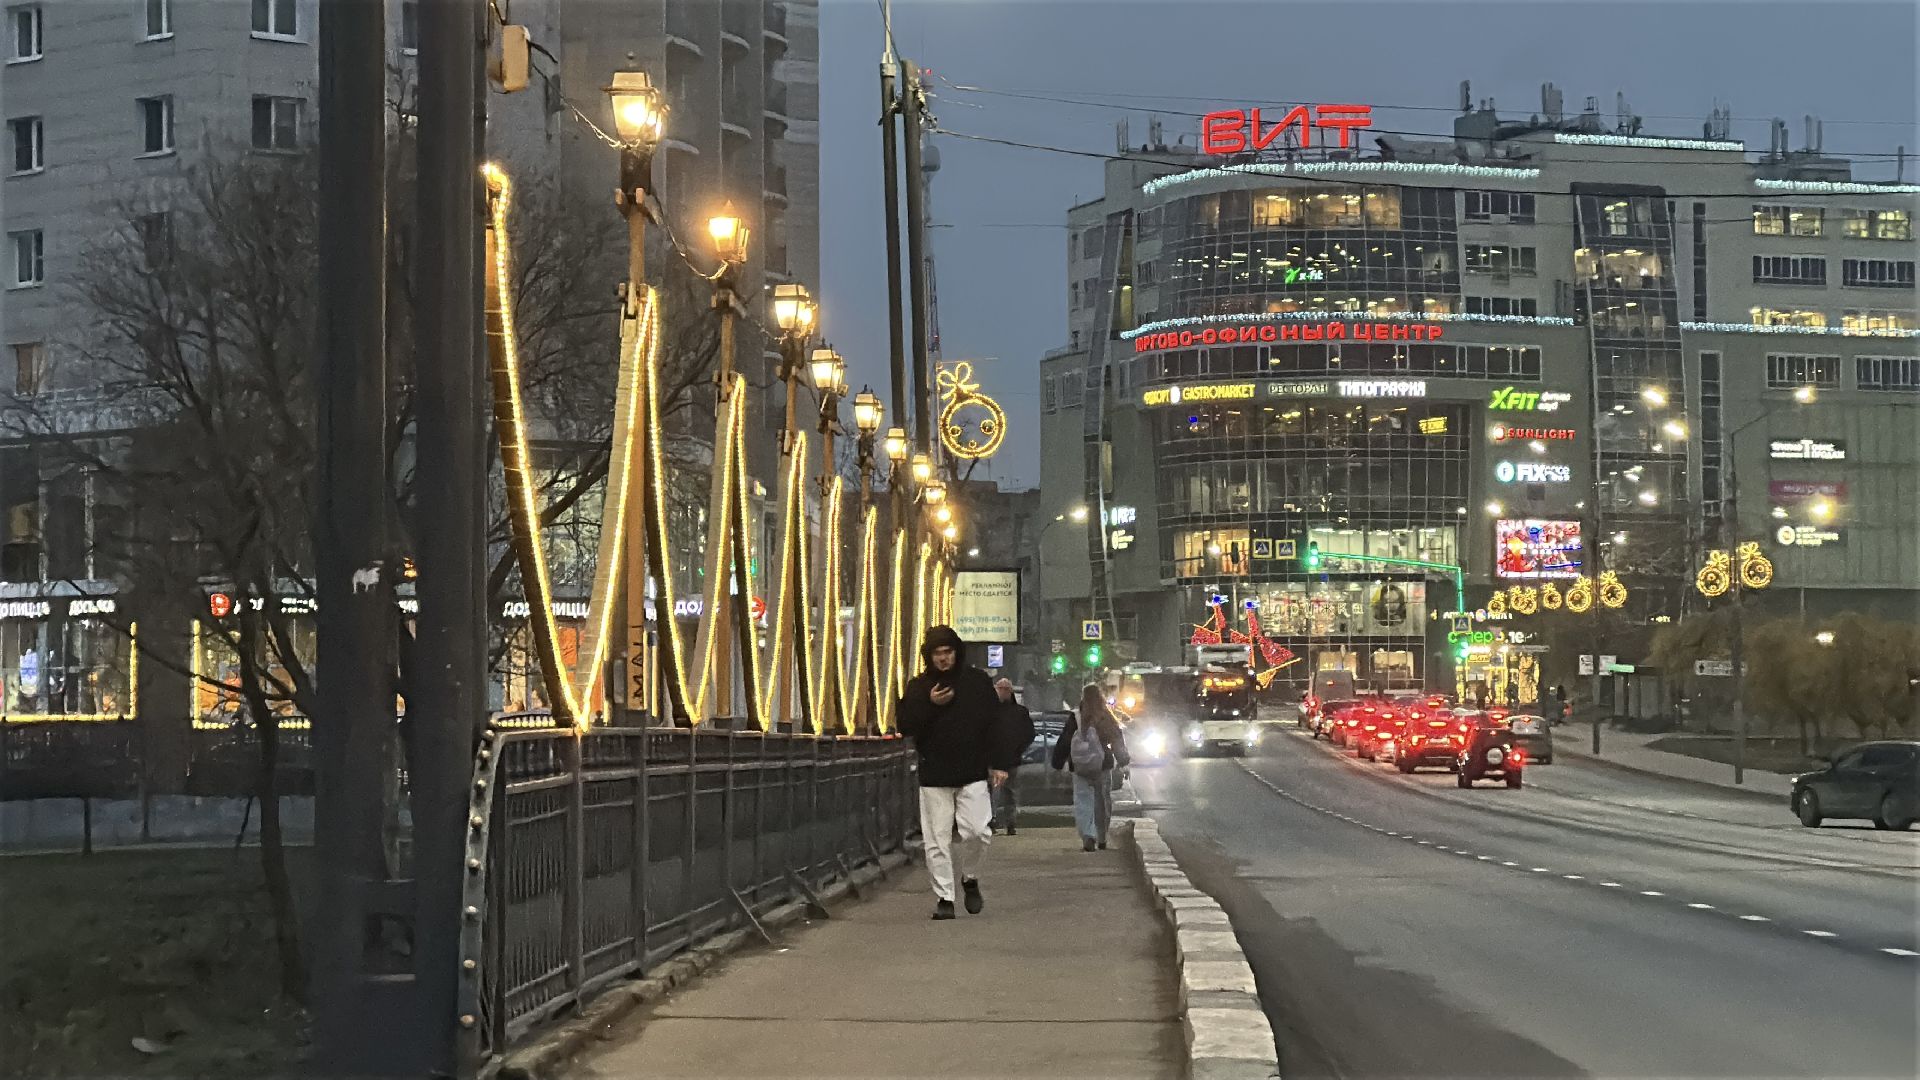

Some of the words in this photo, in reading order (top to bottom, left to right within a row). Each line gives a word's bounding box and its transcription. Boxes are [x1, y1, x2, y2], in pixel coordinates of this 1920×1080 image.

[1202, 104, 1372, 154] ВИТ
[1353, 324, 1443, 342] ЦЕНТР
[1182, 384, 1255, 400] GASTROMARKET
[1269, 383, 1328, 395] РЕСТОРАН
[1338, 381, 1426, 396] ТИПОГРАФИЯ
[1489, 386, 1540, 410] XFIT
[1508, 427, 1576, 440] SUNLIGHT
